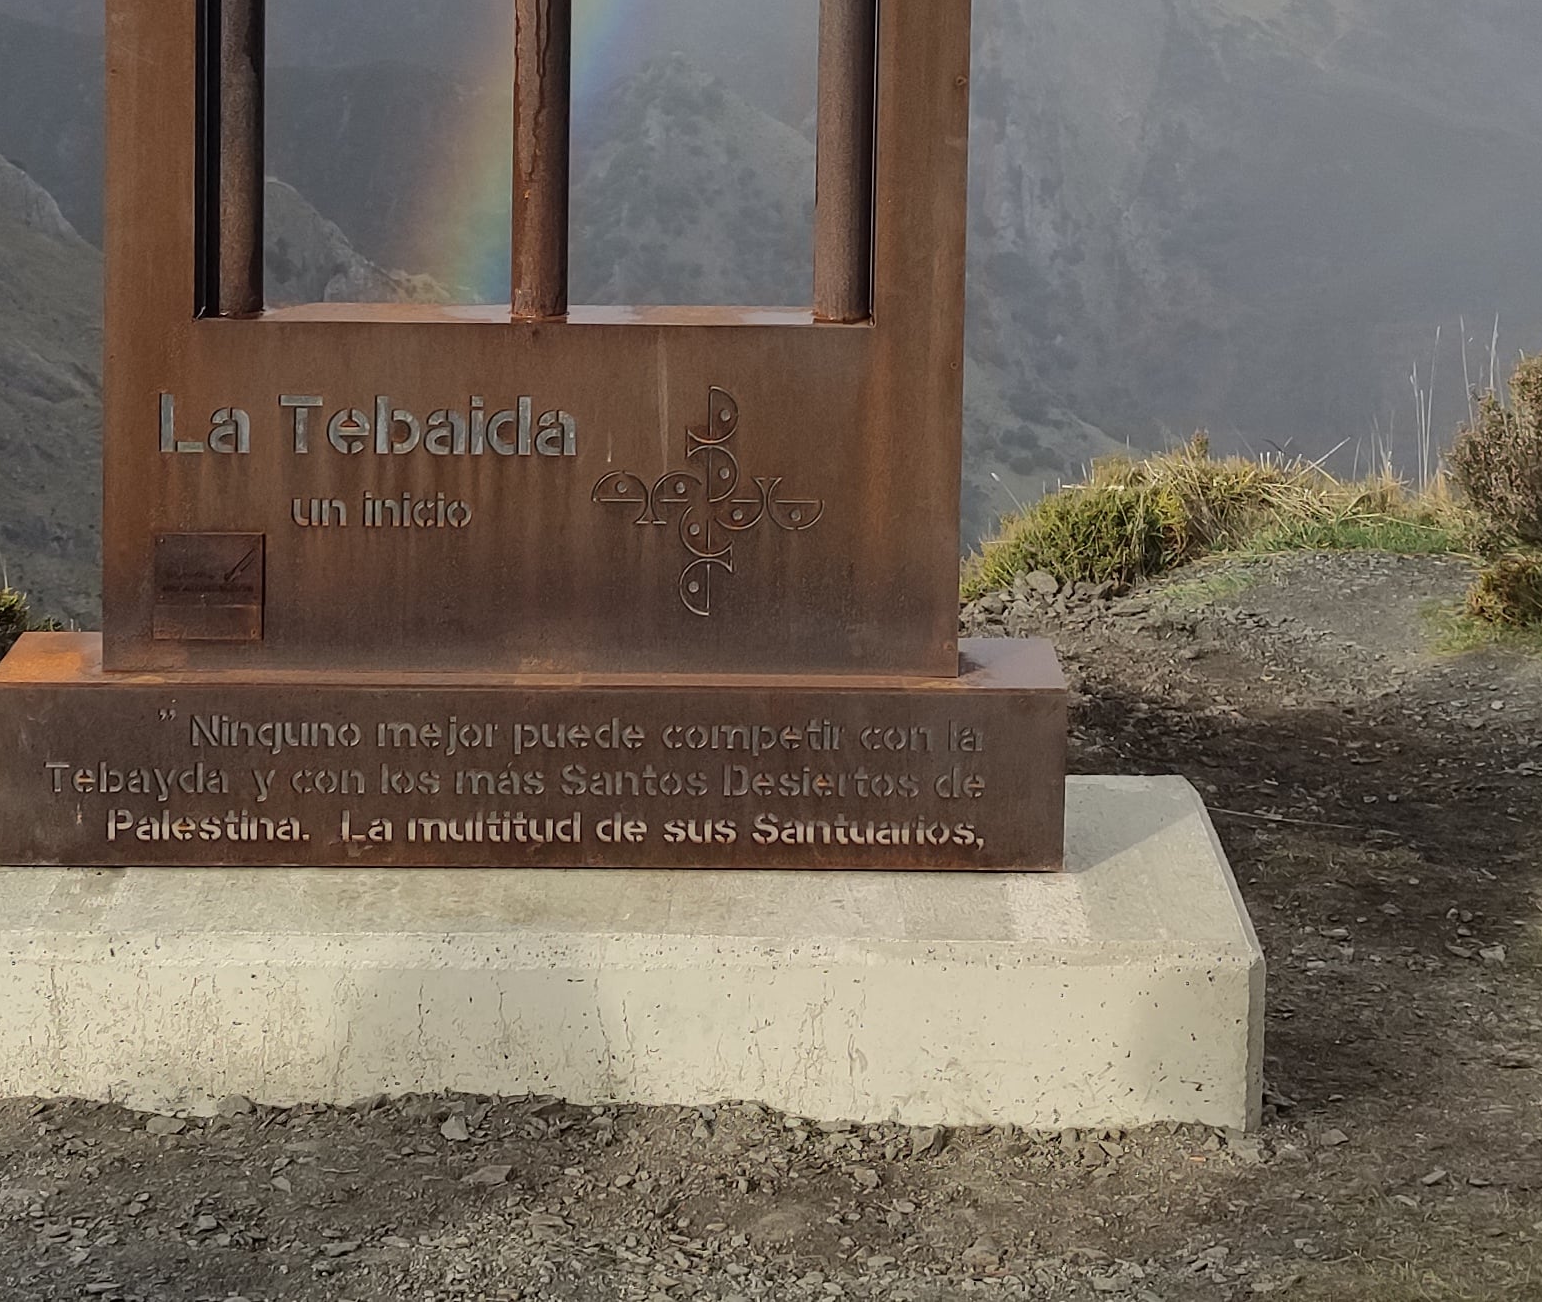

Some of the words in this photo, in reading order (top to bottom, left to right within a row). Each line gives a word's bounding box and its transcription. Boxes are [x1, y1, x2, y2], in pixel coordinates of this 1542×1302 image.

[159, 392, 251, 455] La
[279, 395, 577, 456] Tebaida
[291, 497, 348, 527] un
[362, 492, 473, 529] inicio
[191, 715, 361, 755] Ninguno
[377, 715, 497, 756] mejor
[513, 717, 646, 755] puede
[662, 718, 844, 757] competir
[860, 726, 934, 751] con
[949, 719, 984, 751] la
[45, 761, 229, 802] Tebayda
[252, 769, 276, 802] y
[291, 769, 366, 794] con
[379, 763, 441, 794] los
[455, 761, 545, 795] más
[560, 763, 709, 797] Santos
[722, 764, 919, 798] Desiertos
[934, 765, 986, 798] de
[107, 809, 310, 842] Palestina.
[340, 809, 393, 842] La
[407, 809, 581, 844] multitud
[596, 812, 649, 844] de
[663, 813, 737, 845] sus
[751, 813, 985, 850] Santuarios,
